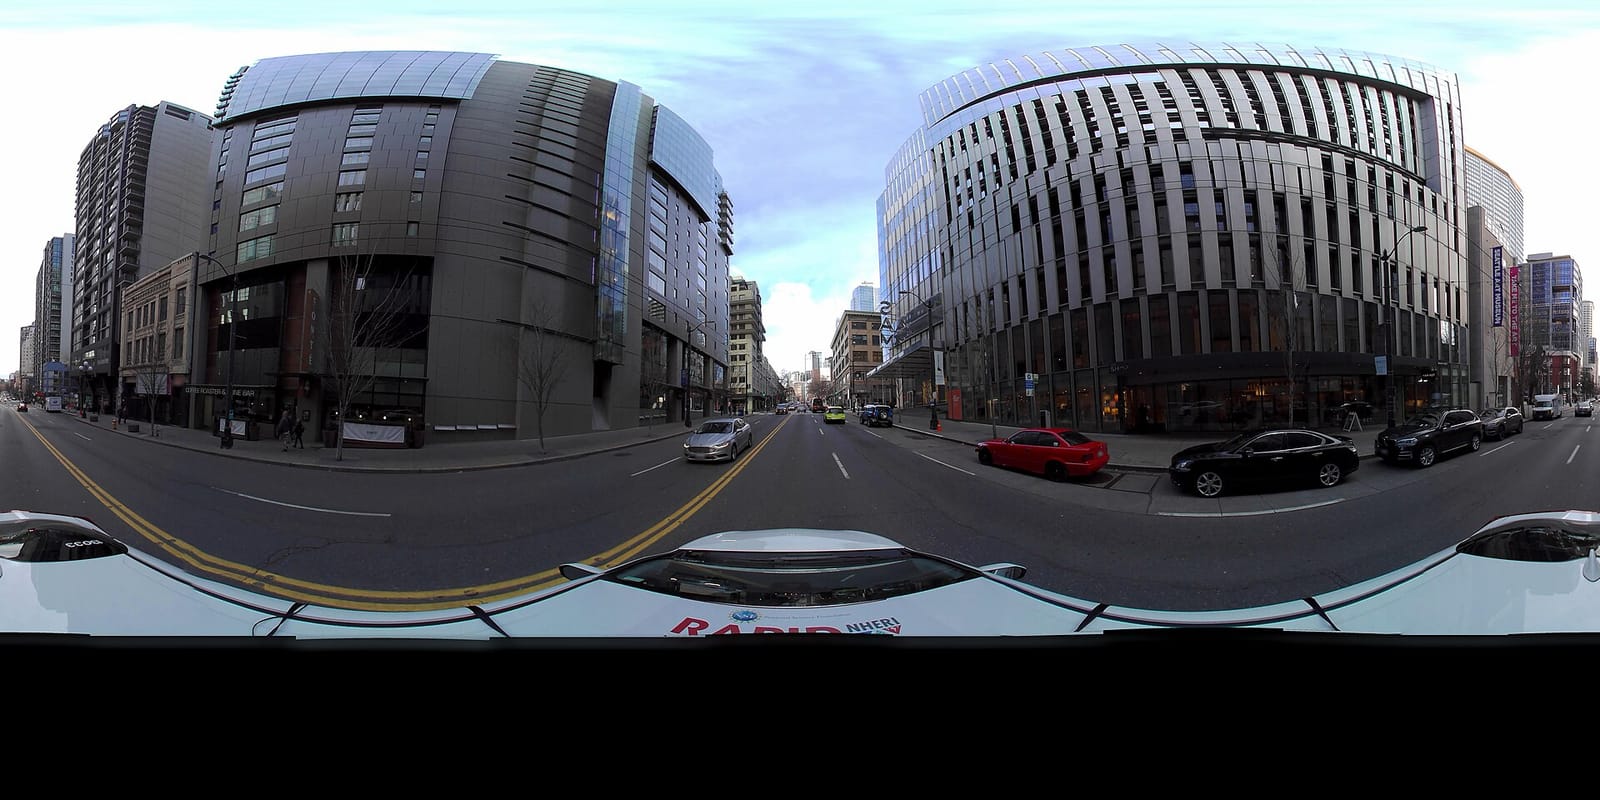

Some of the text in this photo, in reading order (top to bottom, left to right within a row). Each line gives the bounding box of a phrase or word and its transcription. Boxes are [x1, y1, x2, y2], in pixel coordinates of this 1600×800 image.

[1511, 294, 1518, 303] ME
[1511, 304, 1518, 315] TO
[846, 617, 900, 632] NHERI
